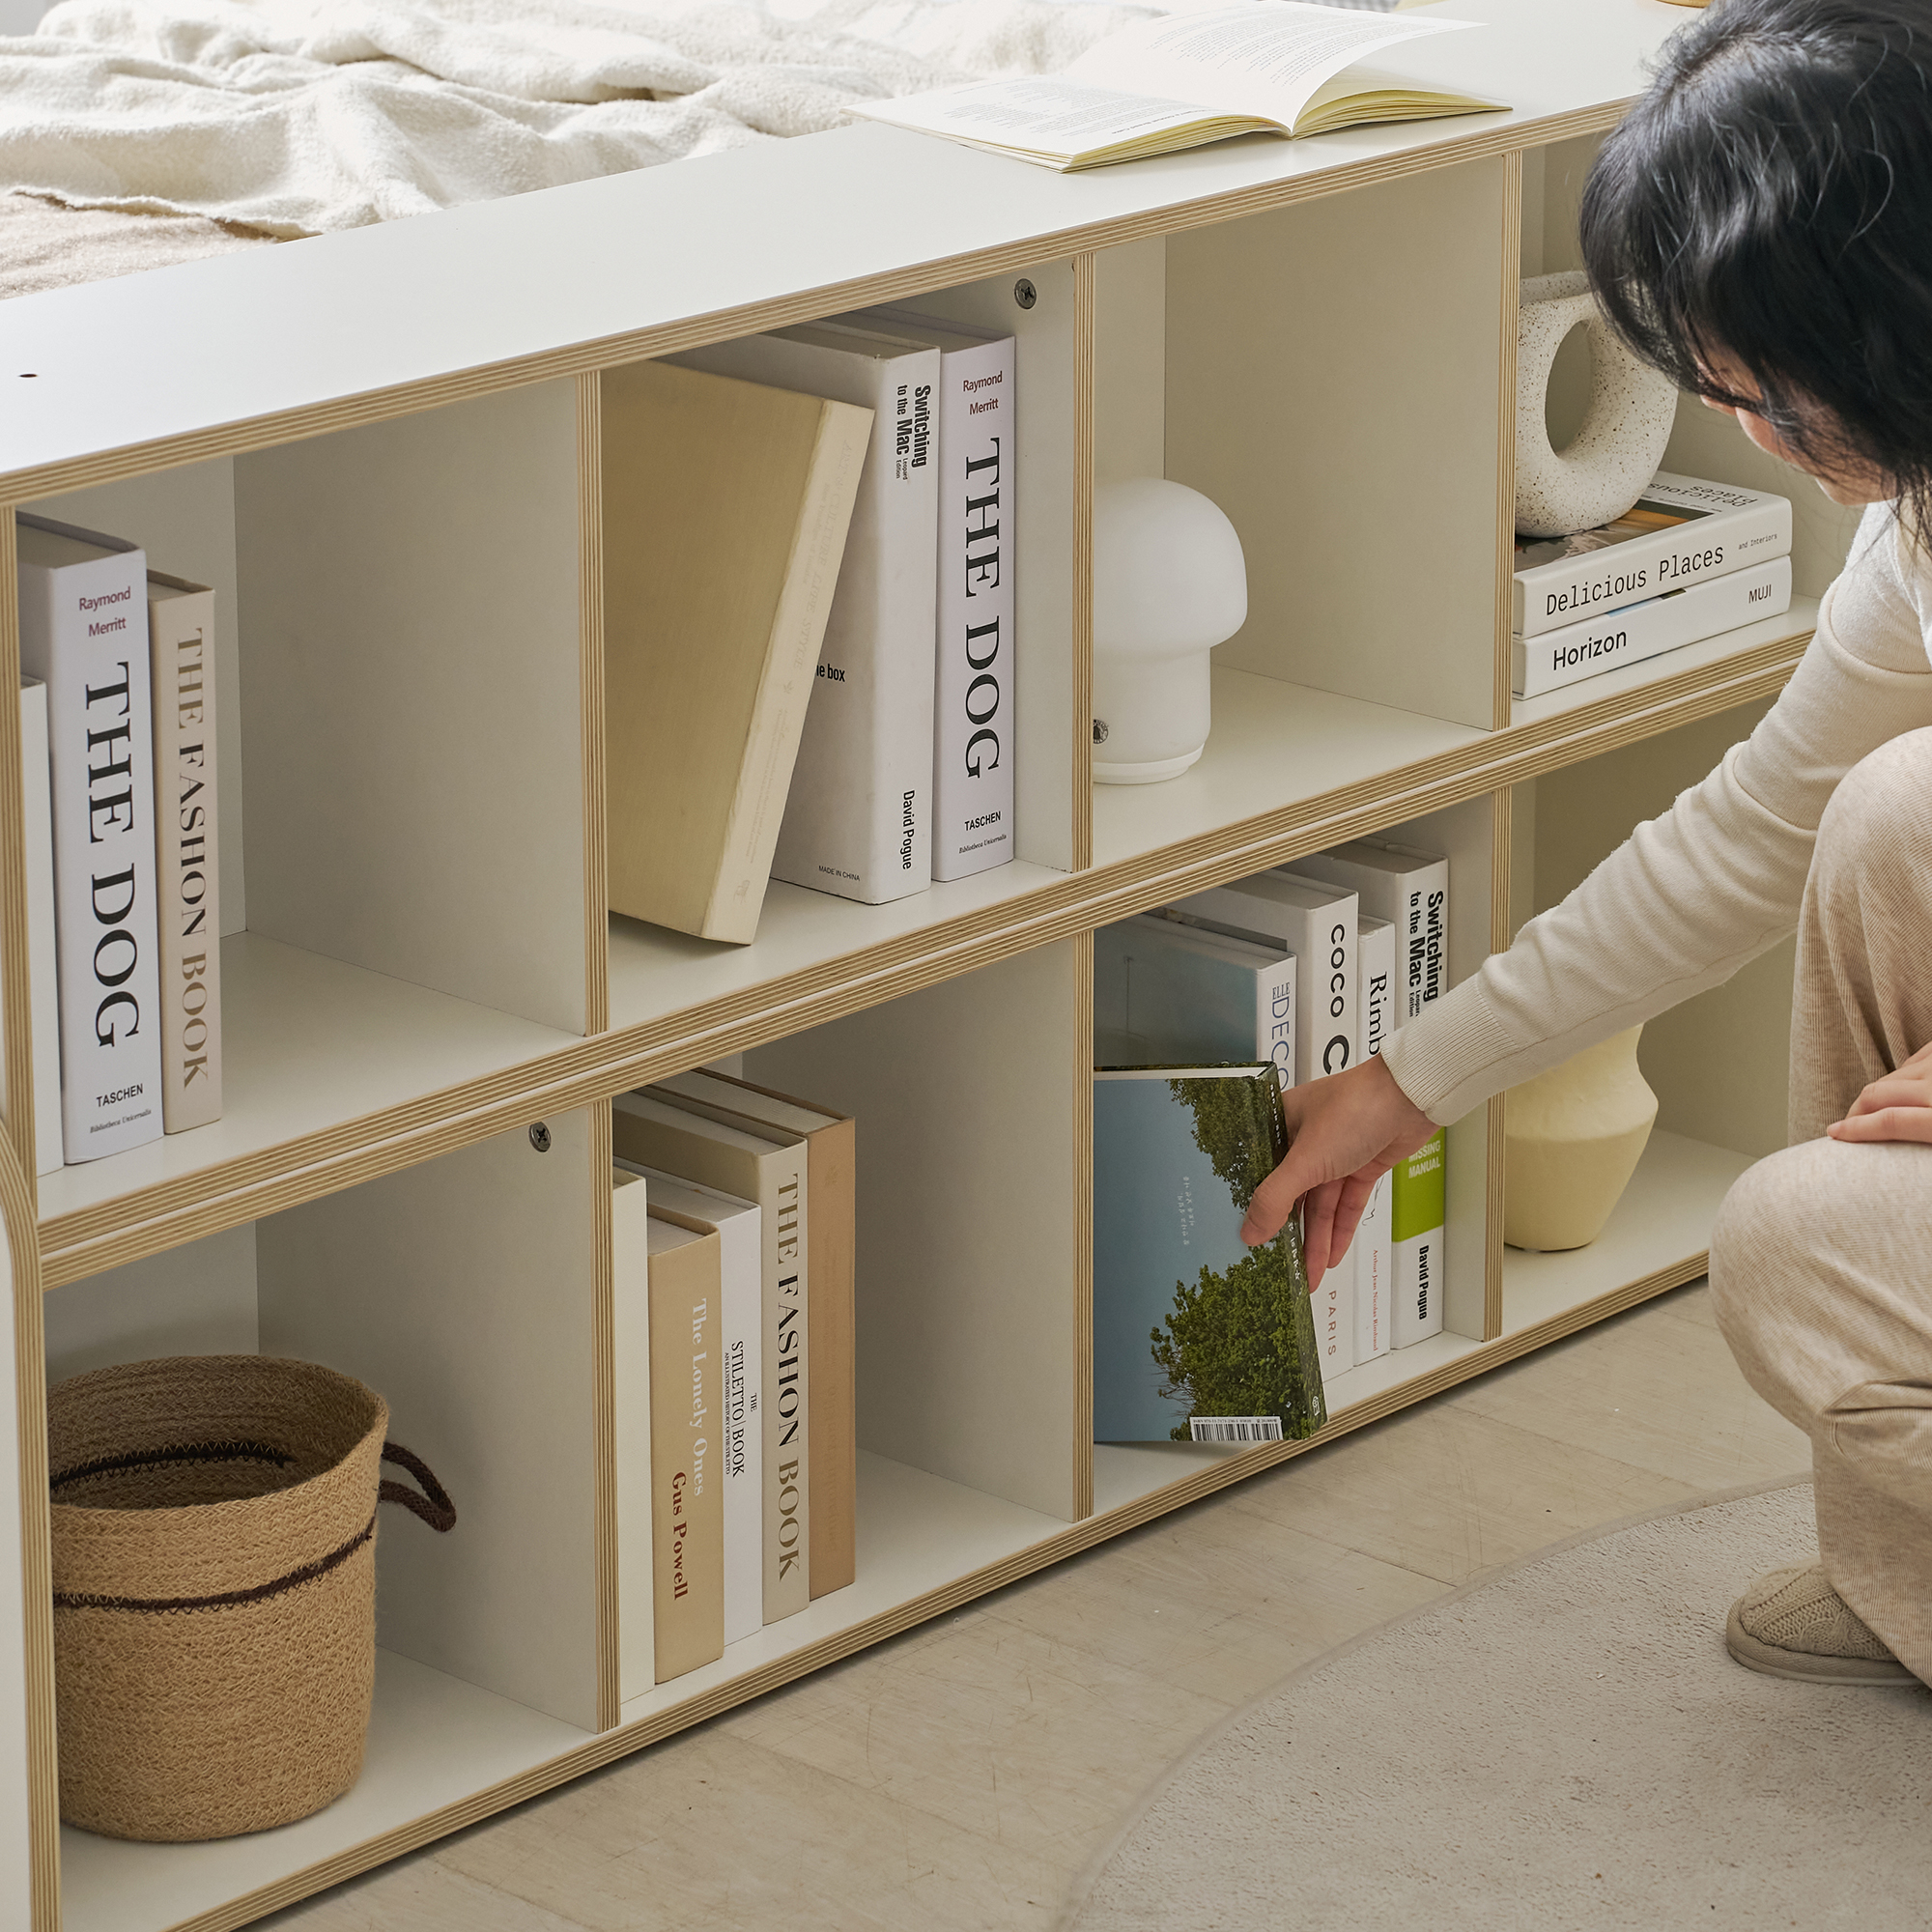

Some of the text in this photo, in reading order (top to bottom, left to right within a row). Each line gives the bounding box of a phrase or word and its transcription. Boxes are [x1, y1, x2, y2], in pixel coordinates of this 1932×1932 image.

[962, 371, 1003, 393] Raymond
[969, 398, 999, 416] Merritt
[896, 384, 913, 456] to the Mac
[911, 384, 931, 469] Switching
[1648, 483, 1747, 507] Delicious
[1690, 485, 1758, 503] Places
[78, 586, 131, 612] Raymond
[965, 437, 1001, 779] THE DOG
[1546, 533, 1777, 616] Delicious Places and Interiors
[88, 616, 127, 638] Merritt
[1553, 583, 1773, 670] Horizon MUJI
[828, 663, 845, 683] box
[85, 661, 139, 1048] THE DOG
[900, 789, 915, 871] David Pogue
[964, 810, 1002, 832] TASCHEN
[177, 628, 209, 1090] THE FASHION BOOK
[818, 865, 835, 875] MADE
[842, 871, 861, 881] CHINA
[1328, 923, 1346, 1018] COCO
[1409, 891, 1425, 987] to the Mac
[1423, 891, 1444, 1003] Switching
[1272, 981, 1291, 1001] ELLE
[96, 1083, 144, 1107] TASCHEN
[1408, 1156, 1441, 1179] MANUAL
[1417, 1244, 1430, 1321] David Pogue
[1327, 1290, 1337, 1355] PARIS
[690, 1297, 708, 1496] The Lonely Ones
[731, 1340, 746, 1478] STILETTO BOOK
[750, 1392, 758, 1412] THE
[778, 1173, 802, 1582] THE FASHION BOOK
[671, 1471, 688, 1601] Gus Powell
